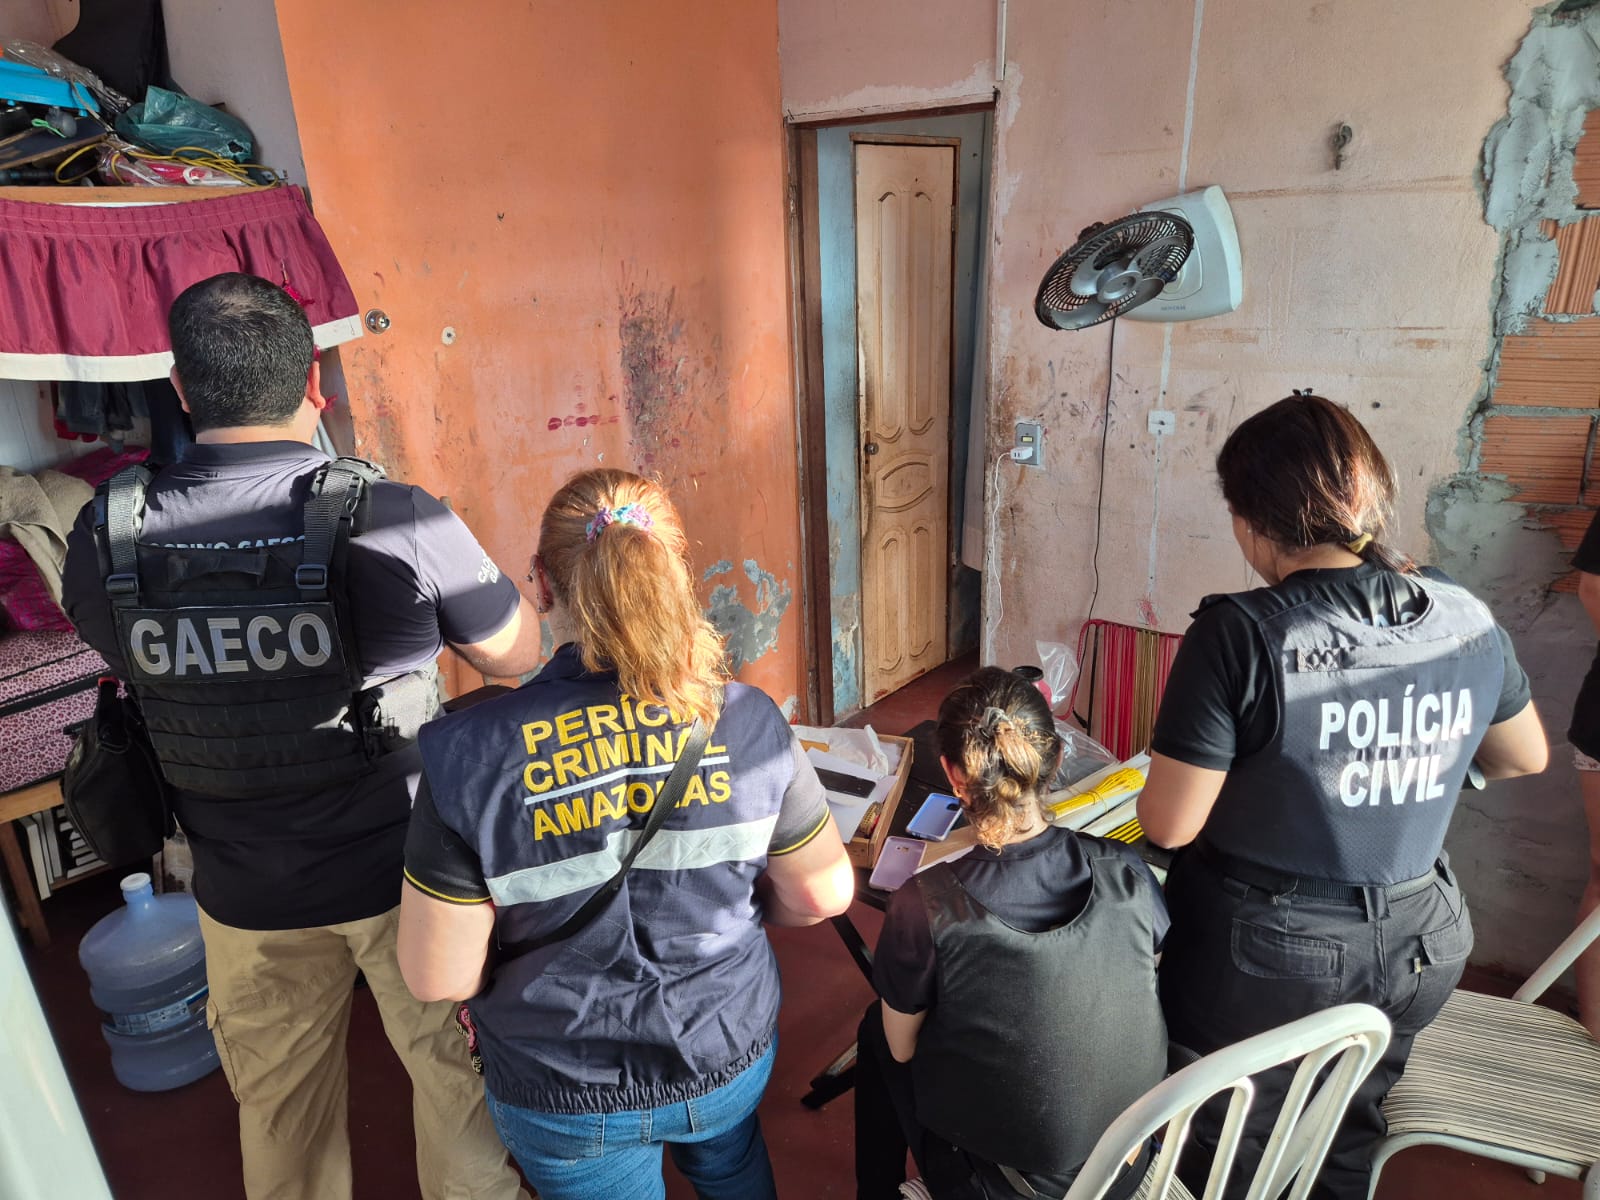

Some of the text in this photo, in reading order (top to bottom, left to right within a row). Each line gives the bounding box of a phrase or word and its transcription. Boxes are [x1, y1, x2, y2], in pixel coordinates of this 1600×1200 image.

[130, 613, 332, 676] GAECO
[1319, 684, 1473, 750] POLÍCIA
[533, 771, 732, 841] AMAZOAS
[1339, 754, 1445, 808] CIVIL
